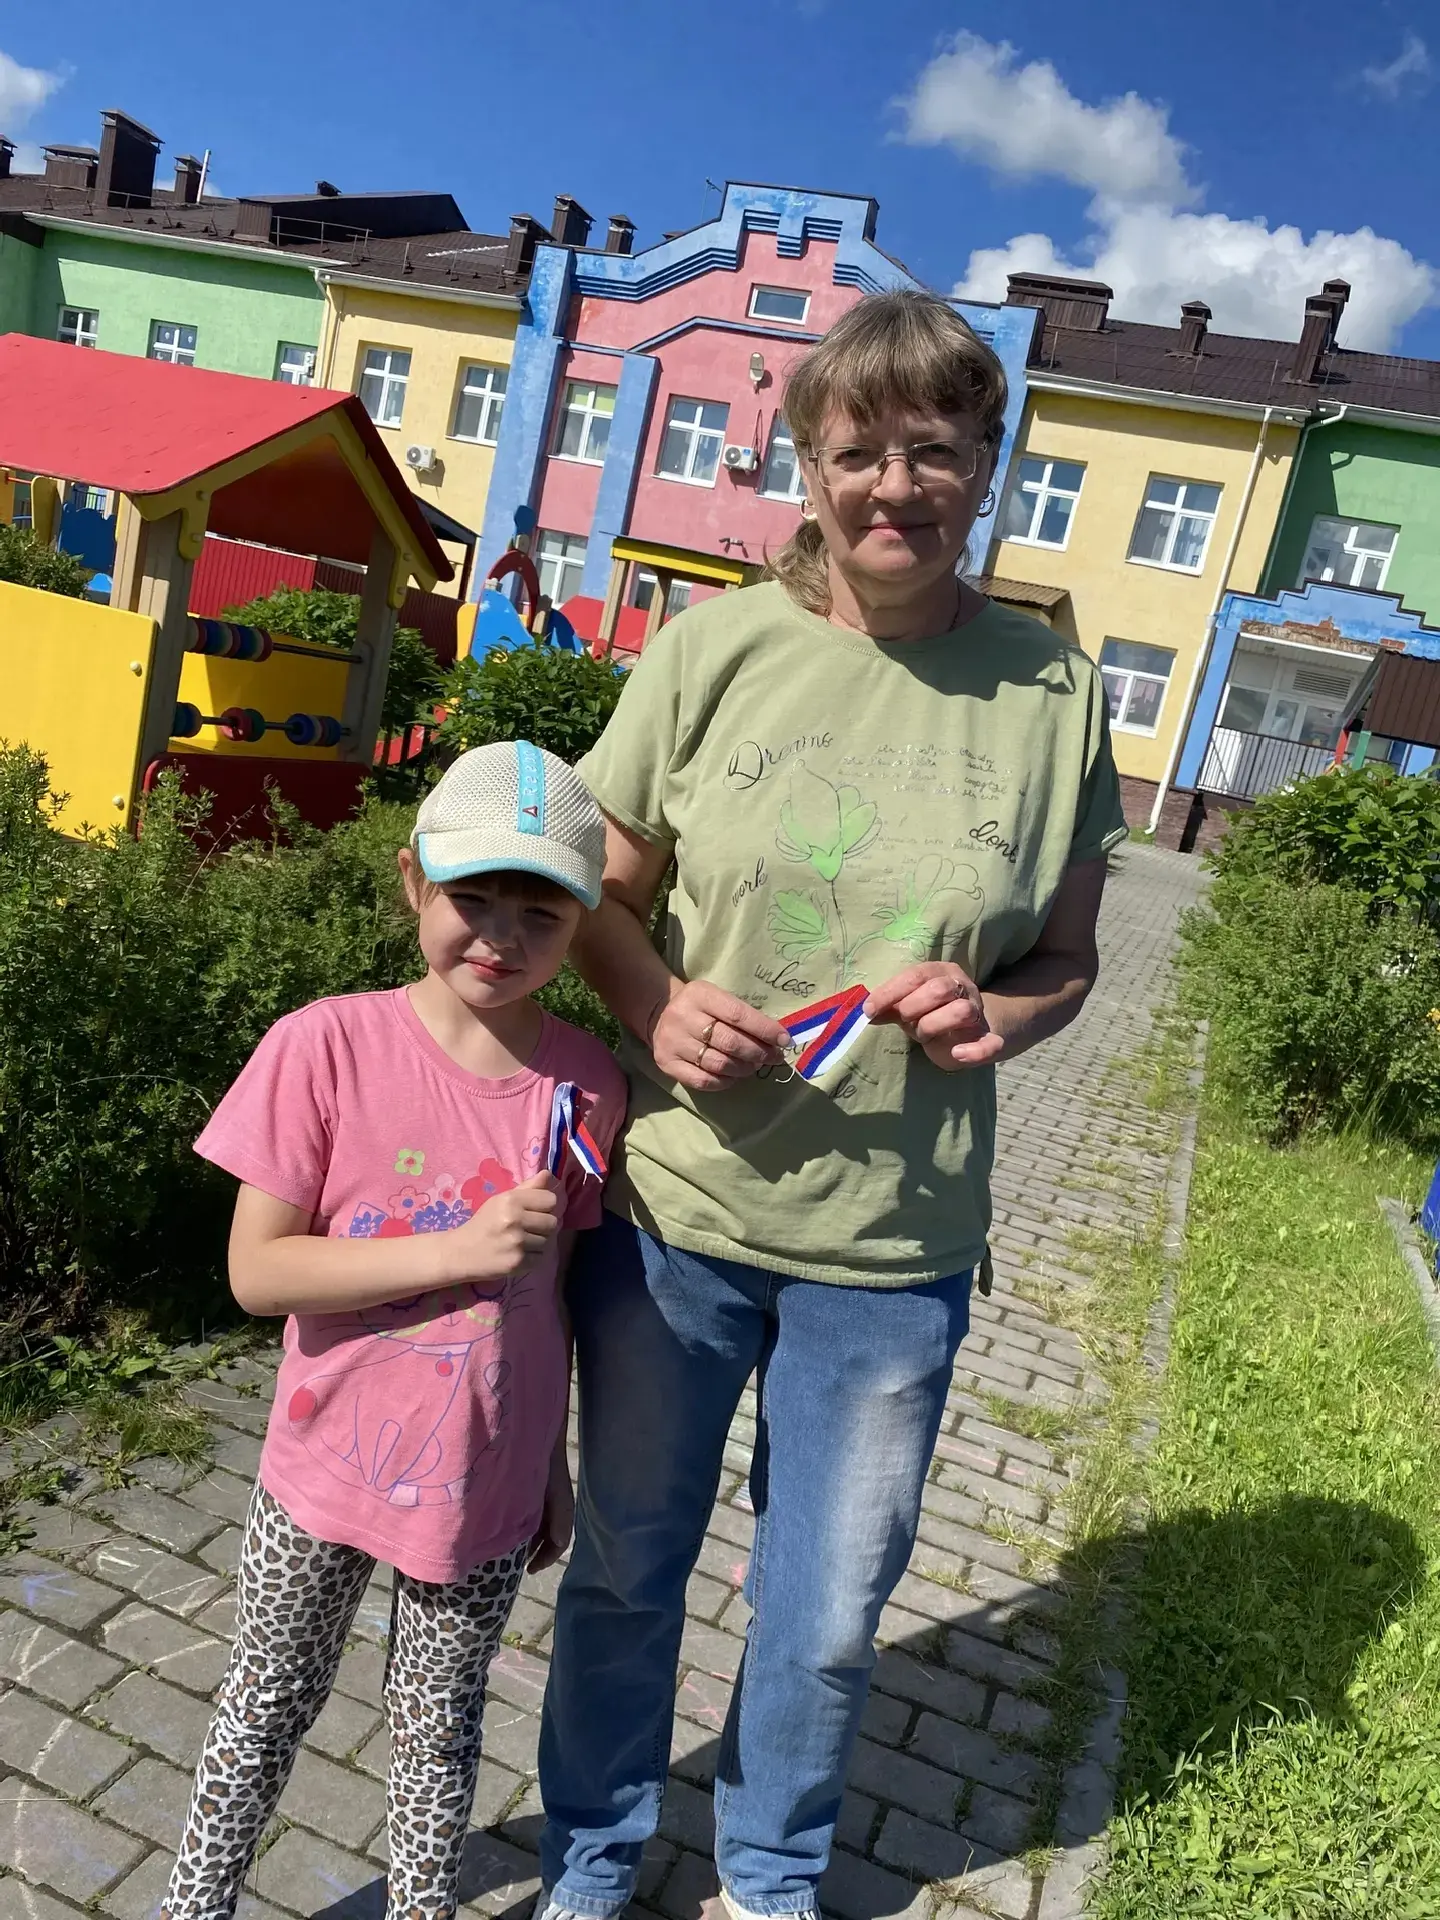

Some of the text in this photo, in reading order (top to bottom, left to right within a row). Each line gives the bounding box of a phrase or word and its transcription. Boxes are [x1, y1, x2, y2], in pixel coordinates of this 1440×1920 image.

[969, 820, 1018, 863] dont
[732, 856, 767, 907] work
[753, 961, 816, 998] unless
